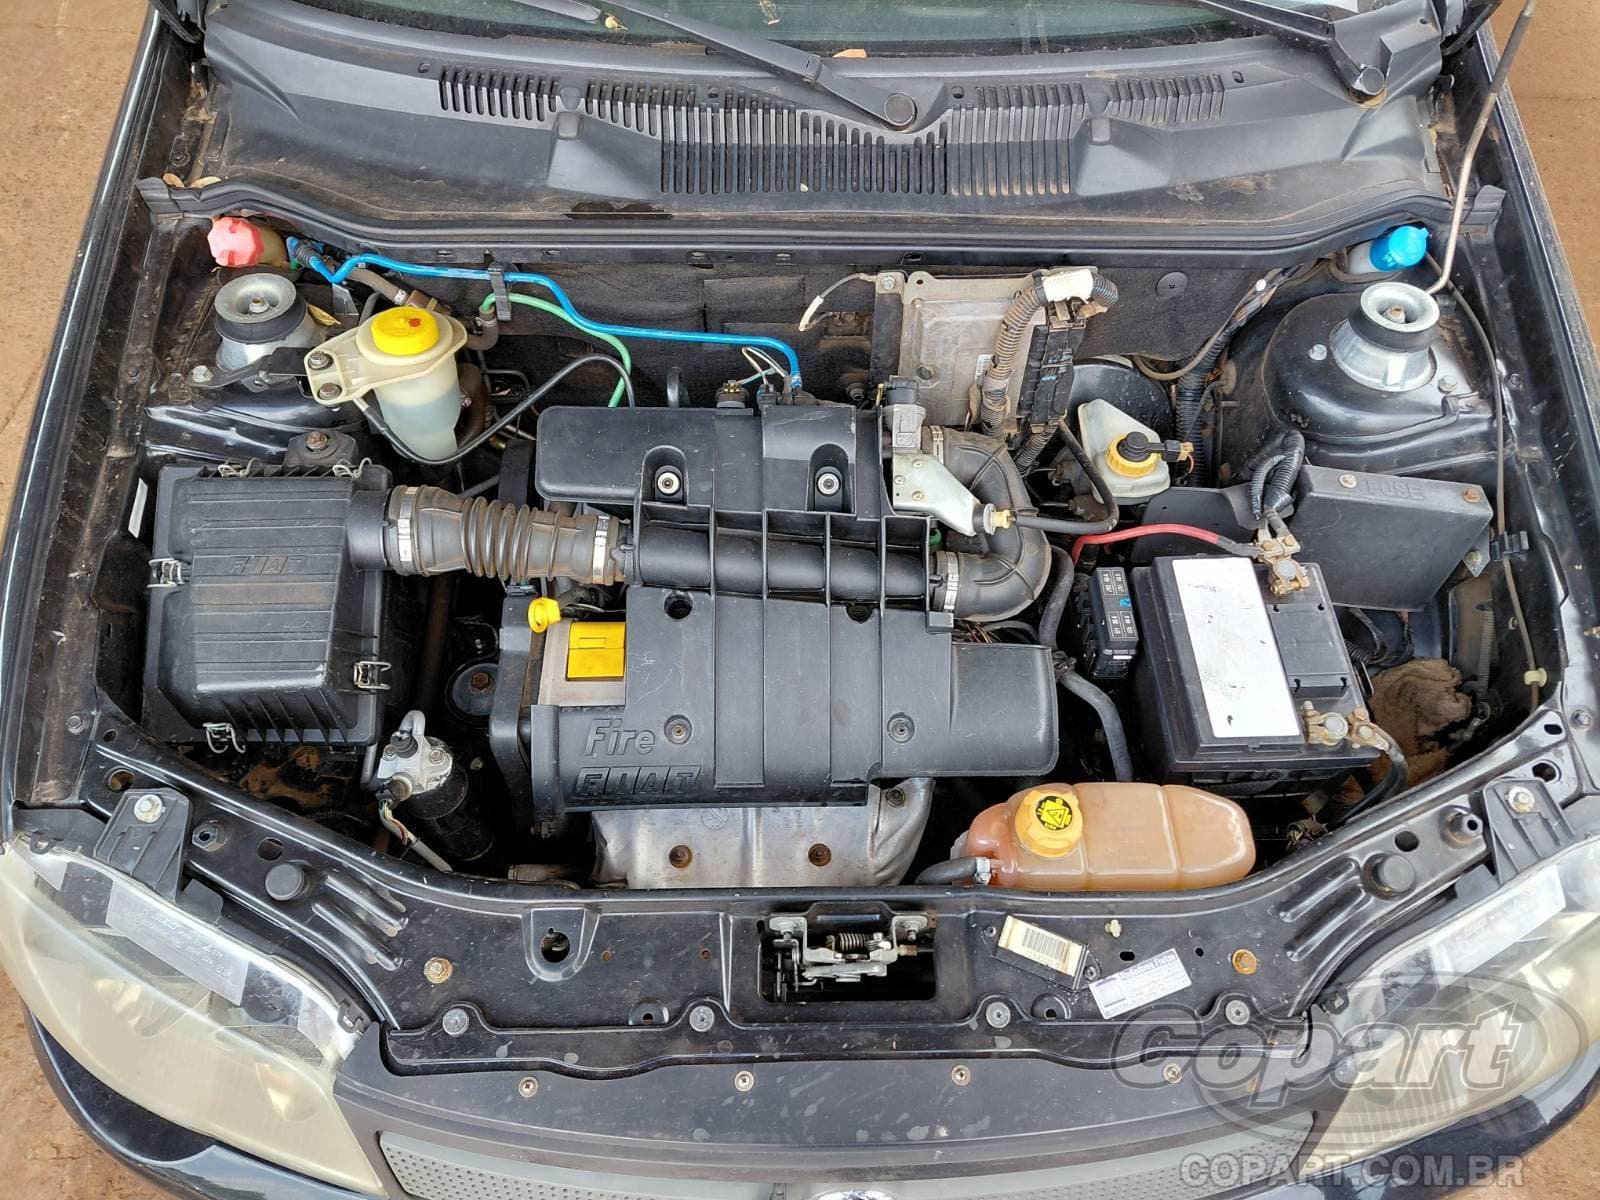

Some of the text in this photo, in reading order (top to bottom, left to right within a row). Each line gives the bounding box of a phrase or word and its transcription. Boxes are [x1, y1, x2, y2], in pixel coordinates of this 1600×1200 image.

[1365, 479, 1424, 500] FUSE
[228, 554, 309, 576] FIAT
[585, 718, 656, 756] Fire
[573, 765, 702, 796] FIAT
